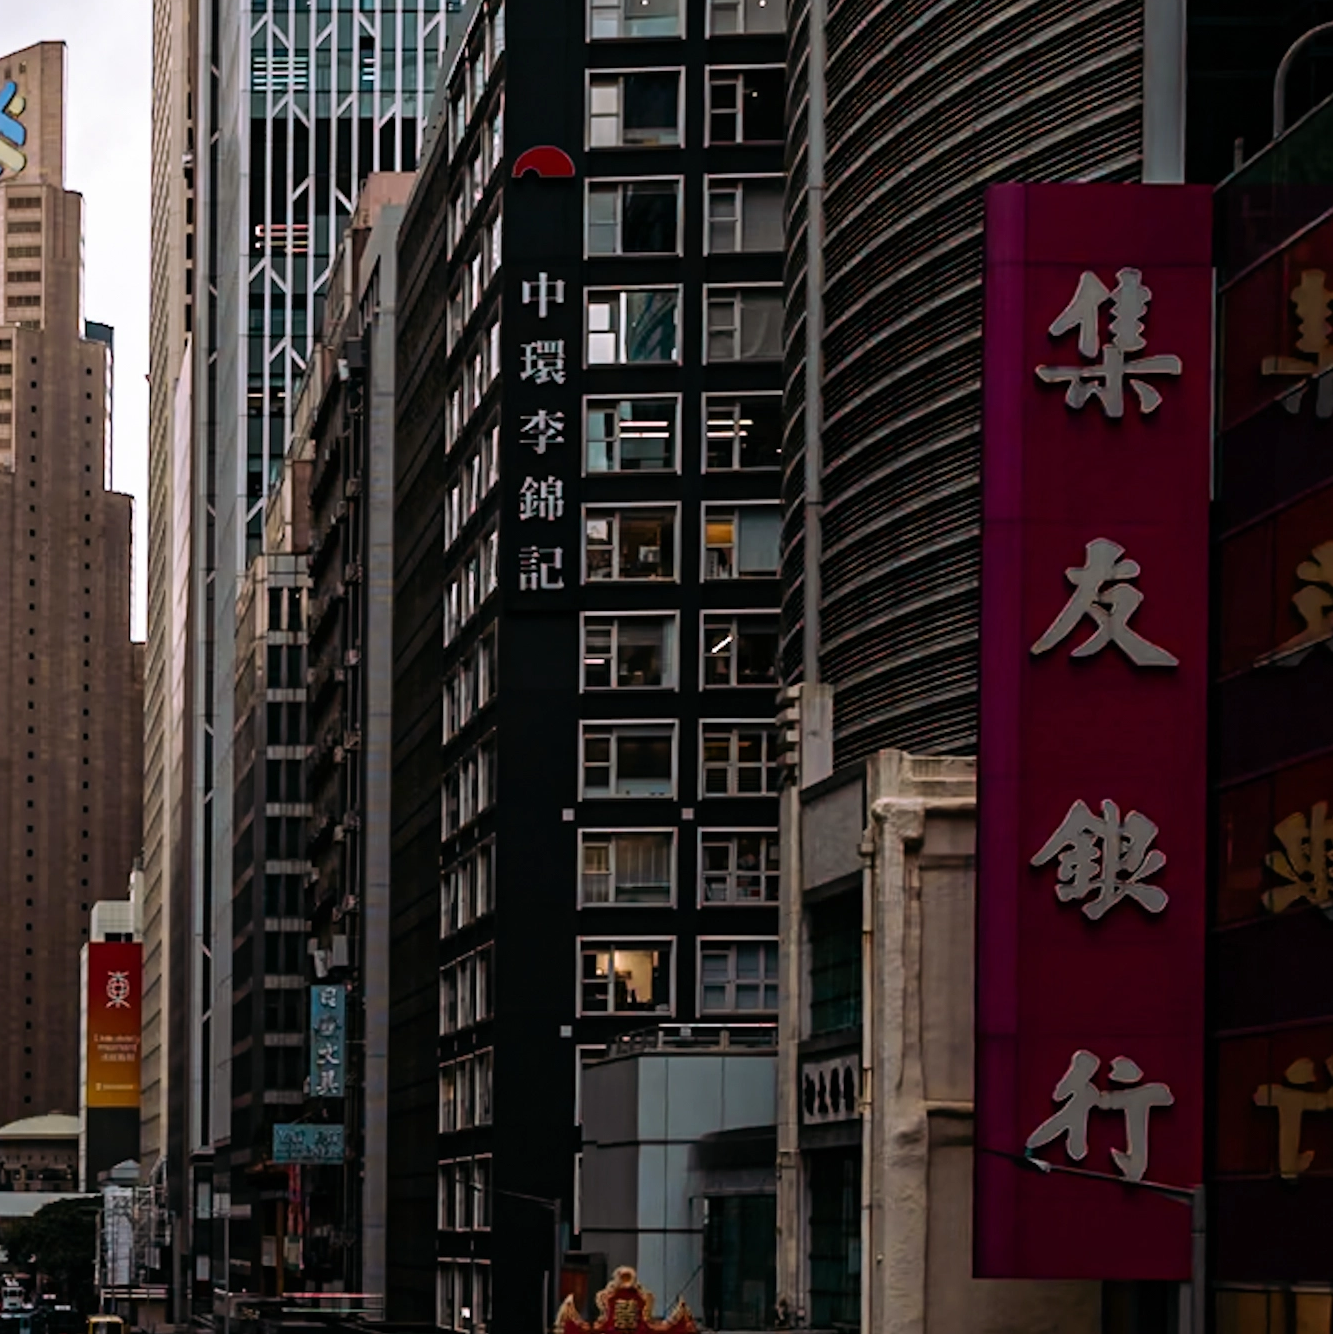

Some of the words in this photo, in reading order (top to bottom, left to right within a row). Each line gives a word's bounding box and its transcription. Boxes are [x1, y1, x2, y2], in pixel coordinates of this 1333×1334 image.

[519, 272, 567, 592] 中環李錦記
[1029, 267, 1183, 1184] 集友銀行
